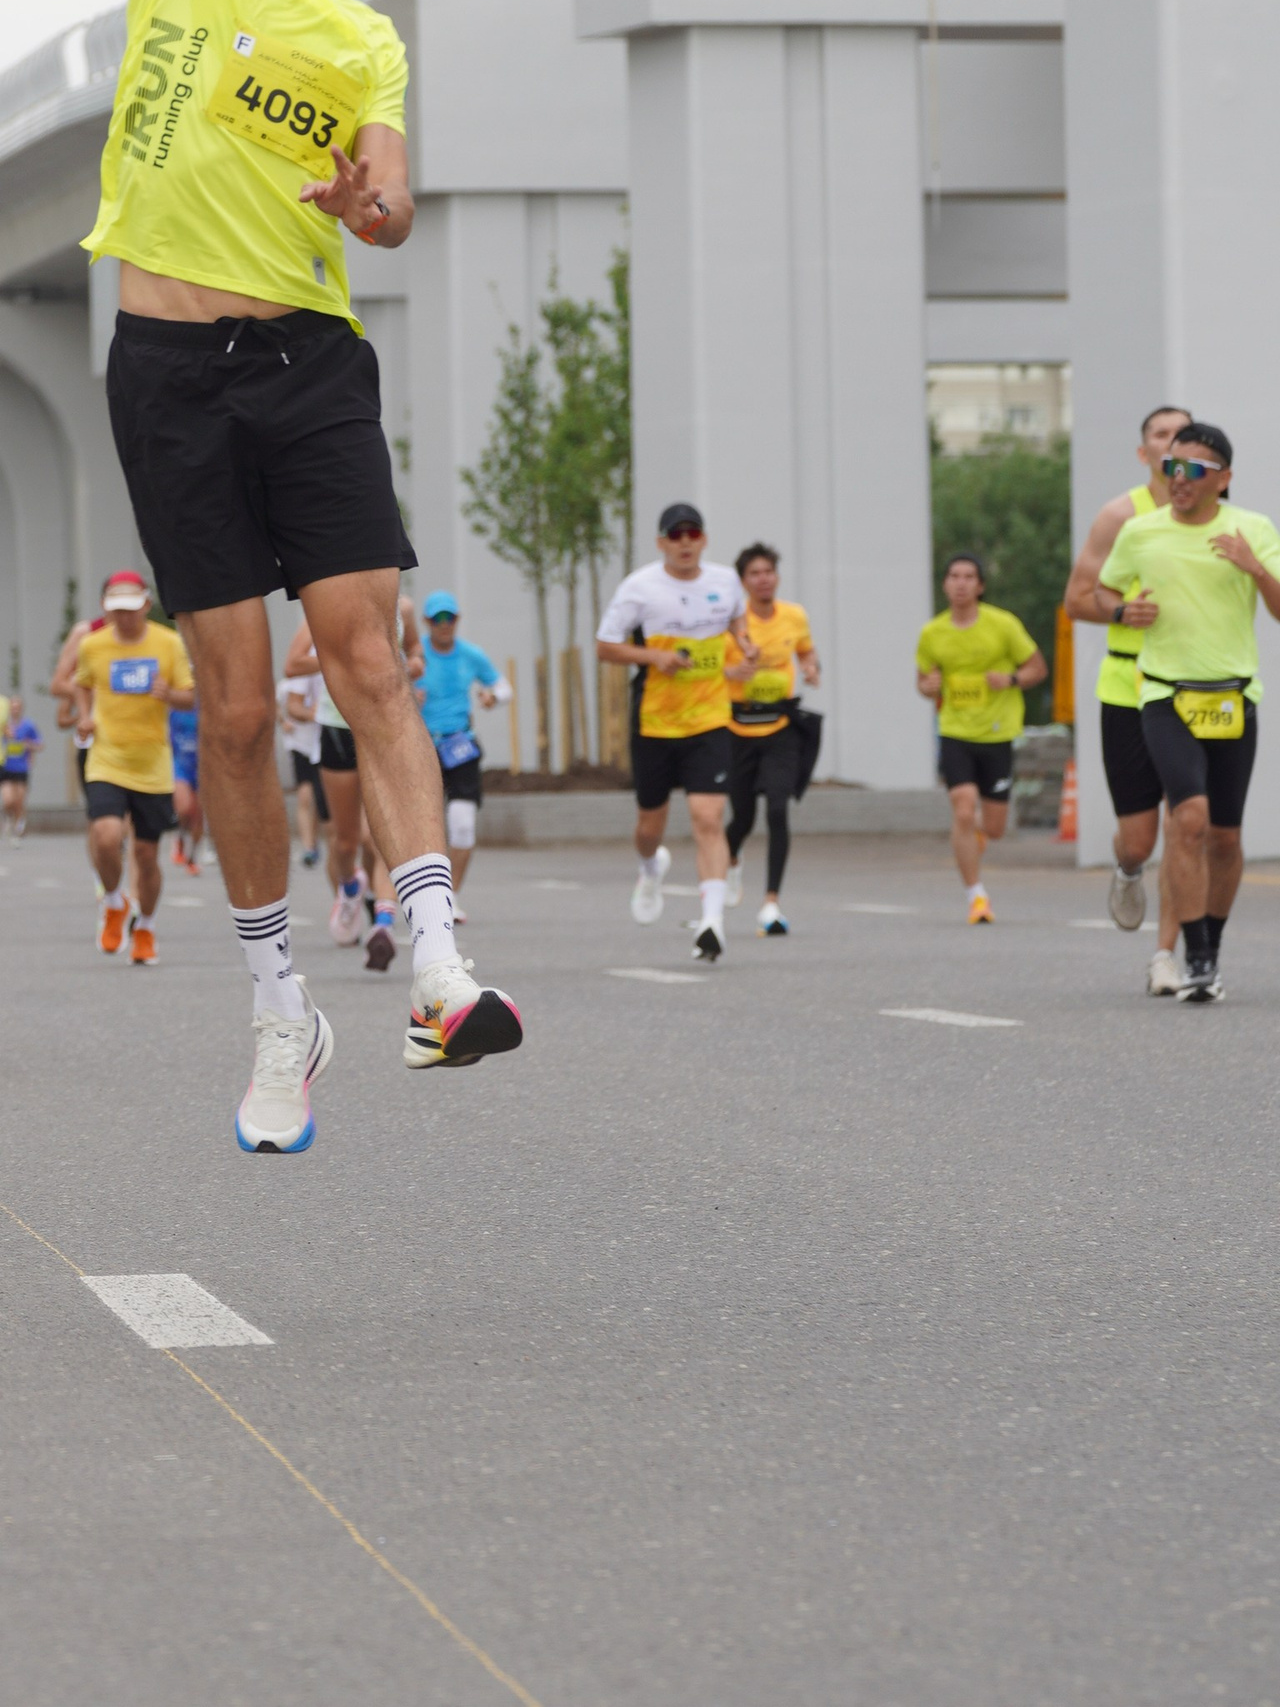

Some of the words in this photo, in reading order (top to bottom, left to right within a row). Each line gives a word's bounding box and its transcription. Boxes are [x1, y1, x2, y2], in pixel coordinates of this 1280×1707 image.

[236, 35, 251, 50] F
[153, 82, 192, 169] running
[182, 27, 209, 76] club
[235, 75, 339, 148] 4093
[1187, 710, 1233, 726] 2799
